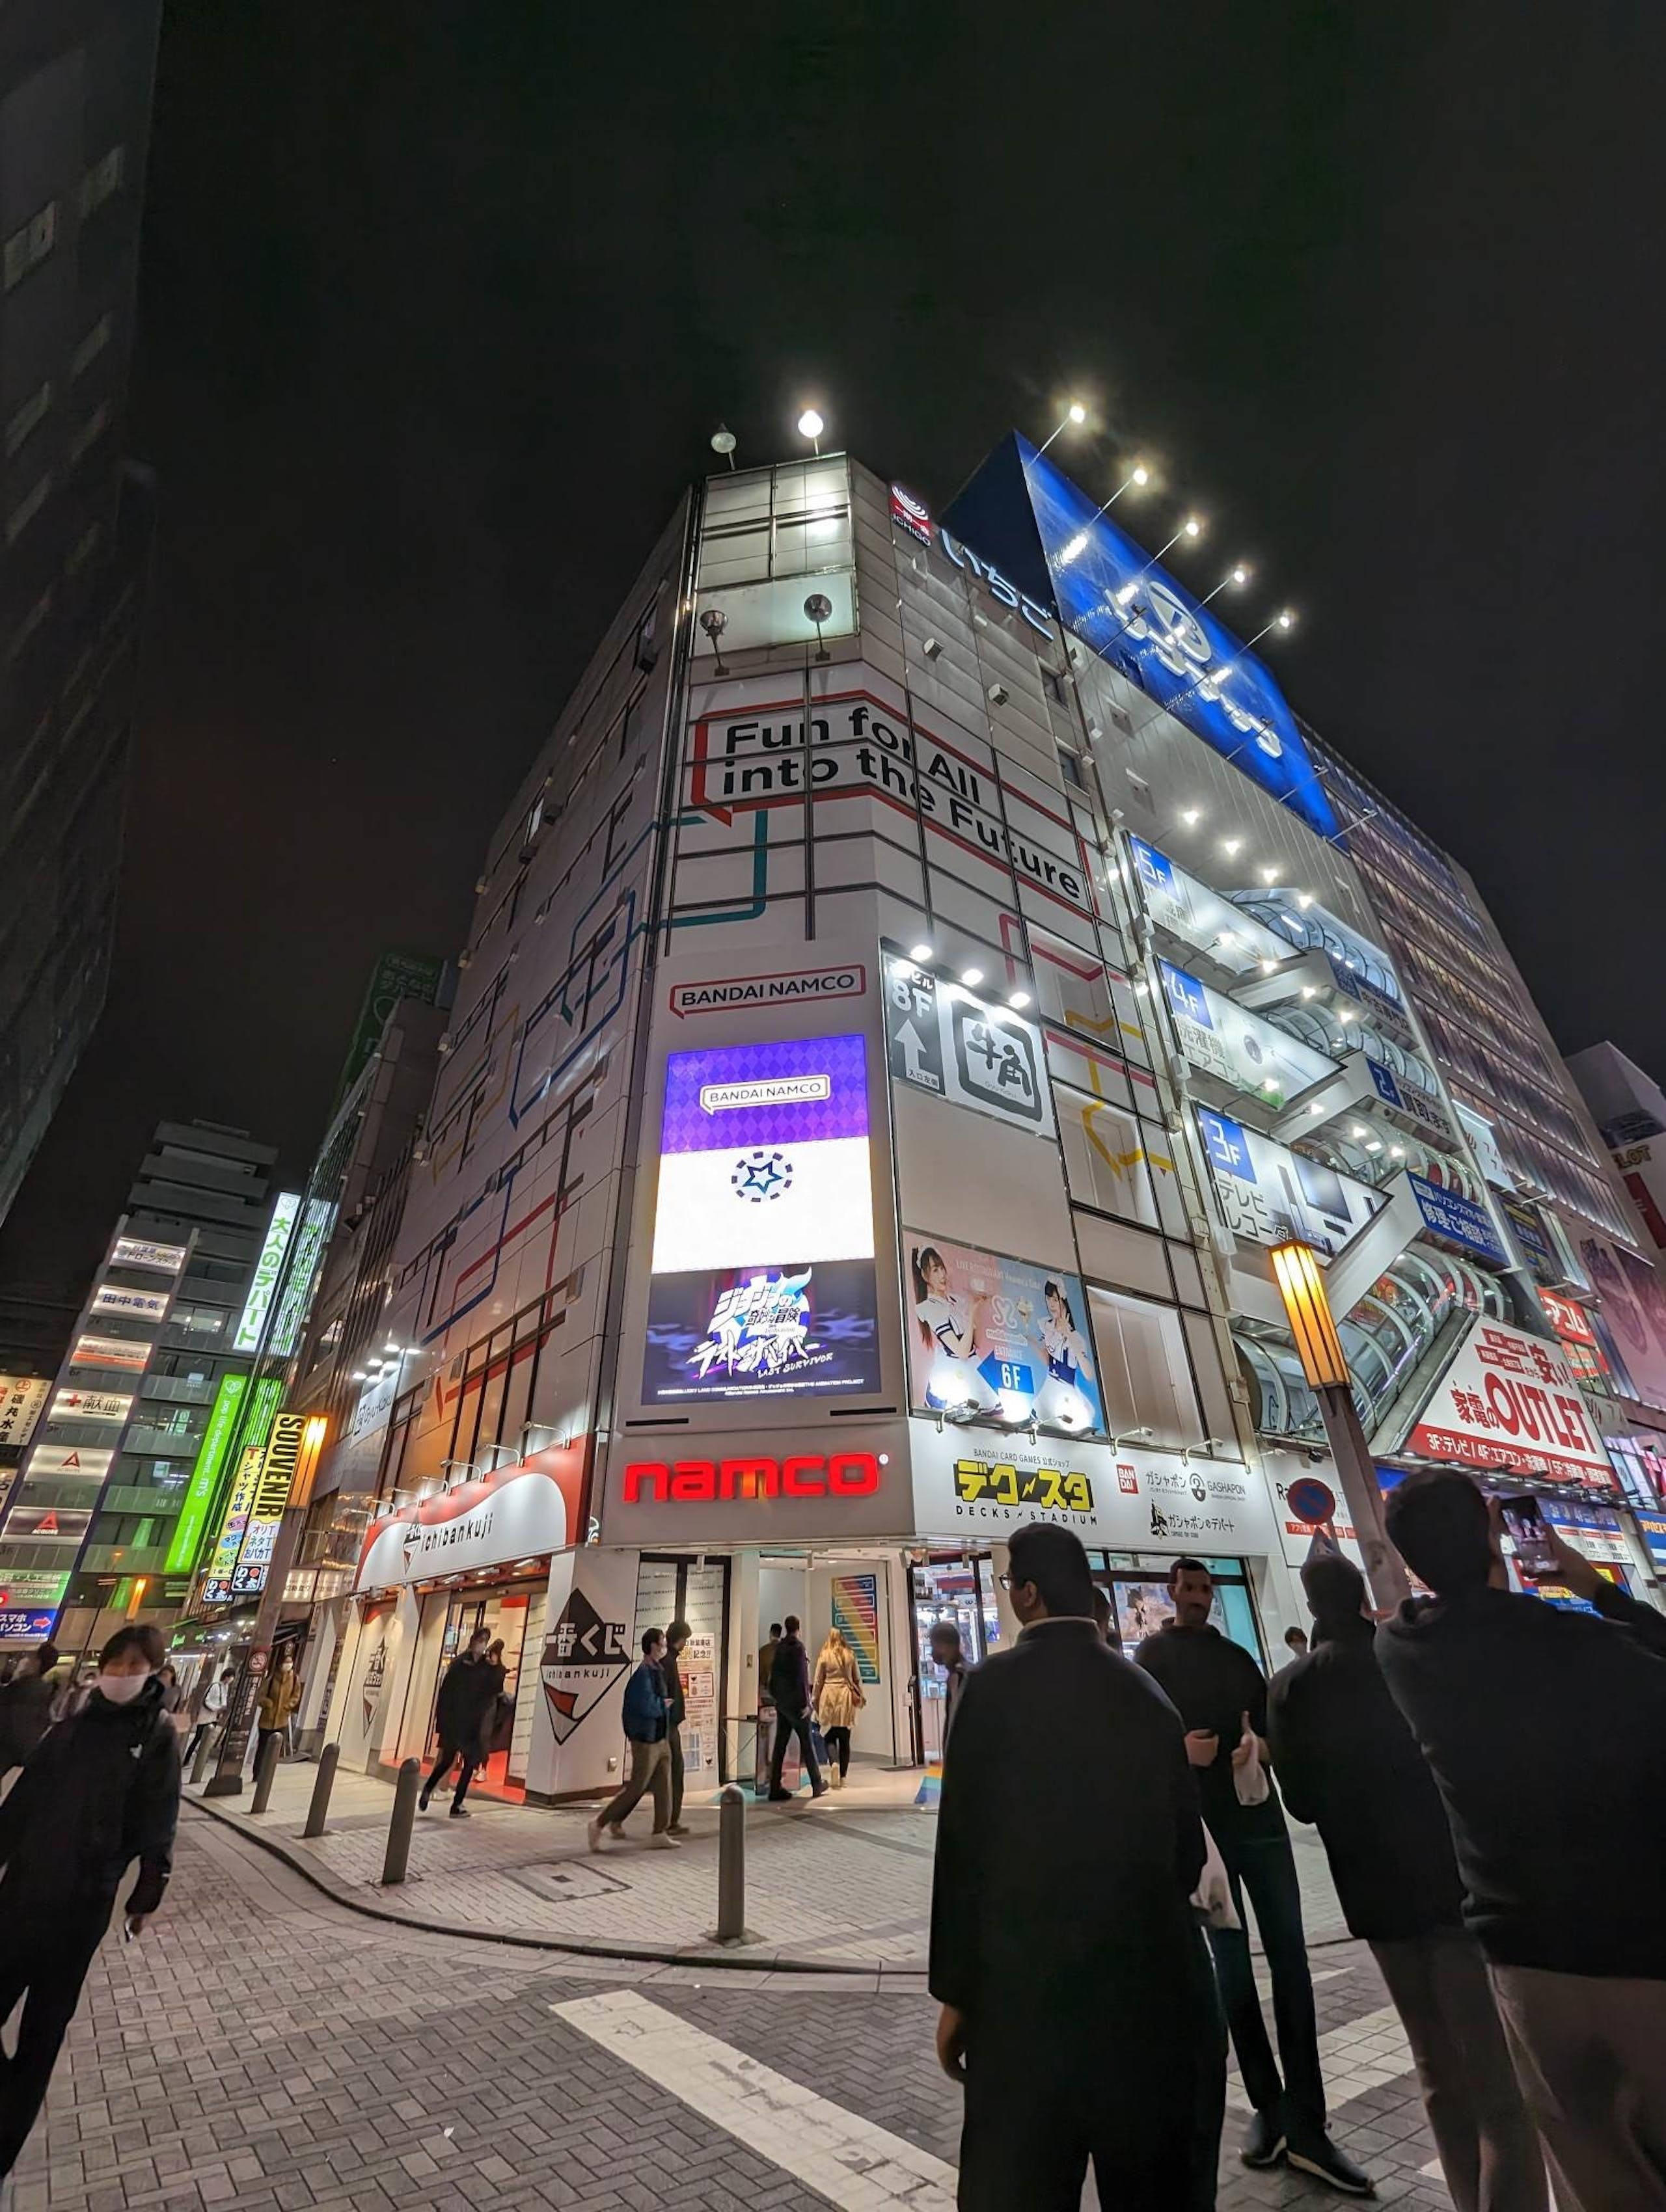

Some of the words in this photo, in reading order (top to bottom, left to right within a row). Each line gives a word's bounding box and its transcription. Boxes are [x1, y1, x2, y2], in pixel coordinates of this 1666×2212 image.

[893, 513, 931, 547] ICHIGO
[726, 714, 830, 755] Fun
[848, 707, 912, 757] for
[928, 752, 980, 805] All
[723, 757, 840, 795] into
[855, 748, 935, 812] the
[951, 798, 1080, 900] Future
[681, 984, 764, 1006] BANDAI
[769, 974, 855, 997] NAMCO
[892, 978, 933, 1018] 8F
[965, 1023, 1032, 1097] 牛角
[709, 1089, 763, 1103] BANDAI
[766, 1082, 822, 1096] NAMCO
[1209, 1118, 1242, 1166] 3F
[1218, 1176, 1268, 1217] テレビ
[237, 1216, 292, 1346] 大人のデパート
[102, 1293, 159, 1310] 田中電気
[757, 1367, 782, 1379] LAST
[782, 1352, 834, 1373] SURVIVOR
[1001, 1363, 1022, 1390] 6F
[83, 1395, 120, 1412] 献血
[256, 1417, 304, 1517] SOUVENIR
[974, 1448, 998, 1460] BANDAI
[1000, 1451, 1017, 1462] CARD
[1018, 1455, 1041, 1464] GAMES
[231, 1448, 260, 1512] Tシャツ作成
[622, 1451, 880, 1504] namco
[1118, 1467, 1134, 1479] BAN
[1121, 1480, 1134, 1490] DAI
[1145, 1470, 1187, 1489] ガシャポン
[1207, 1480, 1246, 1496] GASHAPON
[956, 1505, 1010, 1519] DECKS
[1030, 1511, 1098, 1526] STADIUM
[1168, 1513, 1236, 1533] ガシャポンのデパート
[420, 1512, 493, 1553] ichibankuji
[545, 1622, 625, 1658] 一番くじ
[545, 1667, 610, 1679] ichibankuji
